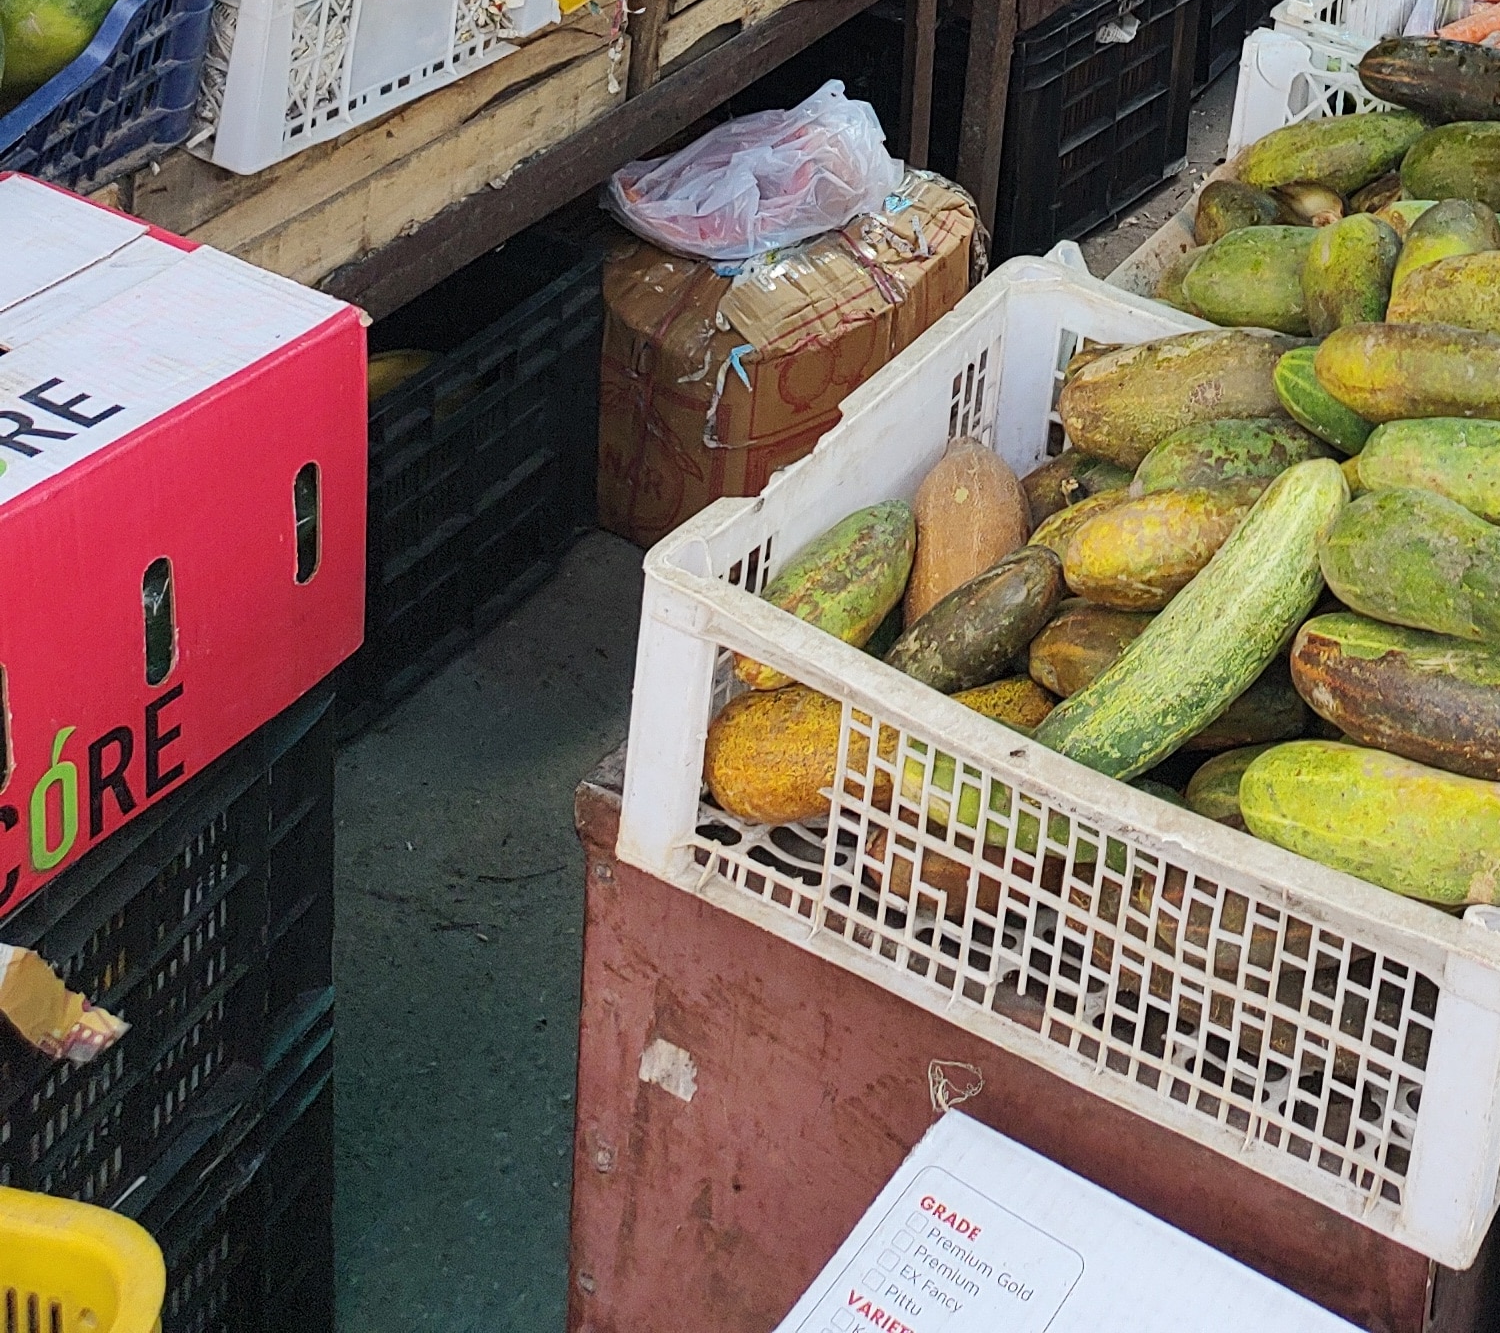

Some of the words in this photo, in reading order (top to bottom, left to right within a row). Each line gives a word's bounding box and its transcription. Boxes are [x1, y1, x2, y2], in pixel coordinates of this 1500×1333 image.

[919, 1195, 983, 1242] GRADE
[899, 1263, 918, 1285] EX
[920, 1279, 964, 1314] Fancy
[913, 1244, 981, 1297] Premium
[927, 1226, 994, 1278] Premium
[996, 1272, 1035, 1302] Gold
[884, 1283, 923, 1317] Pittu
